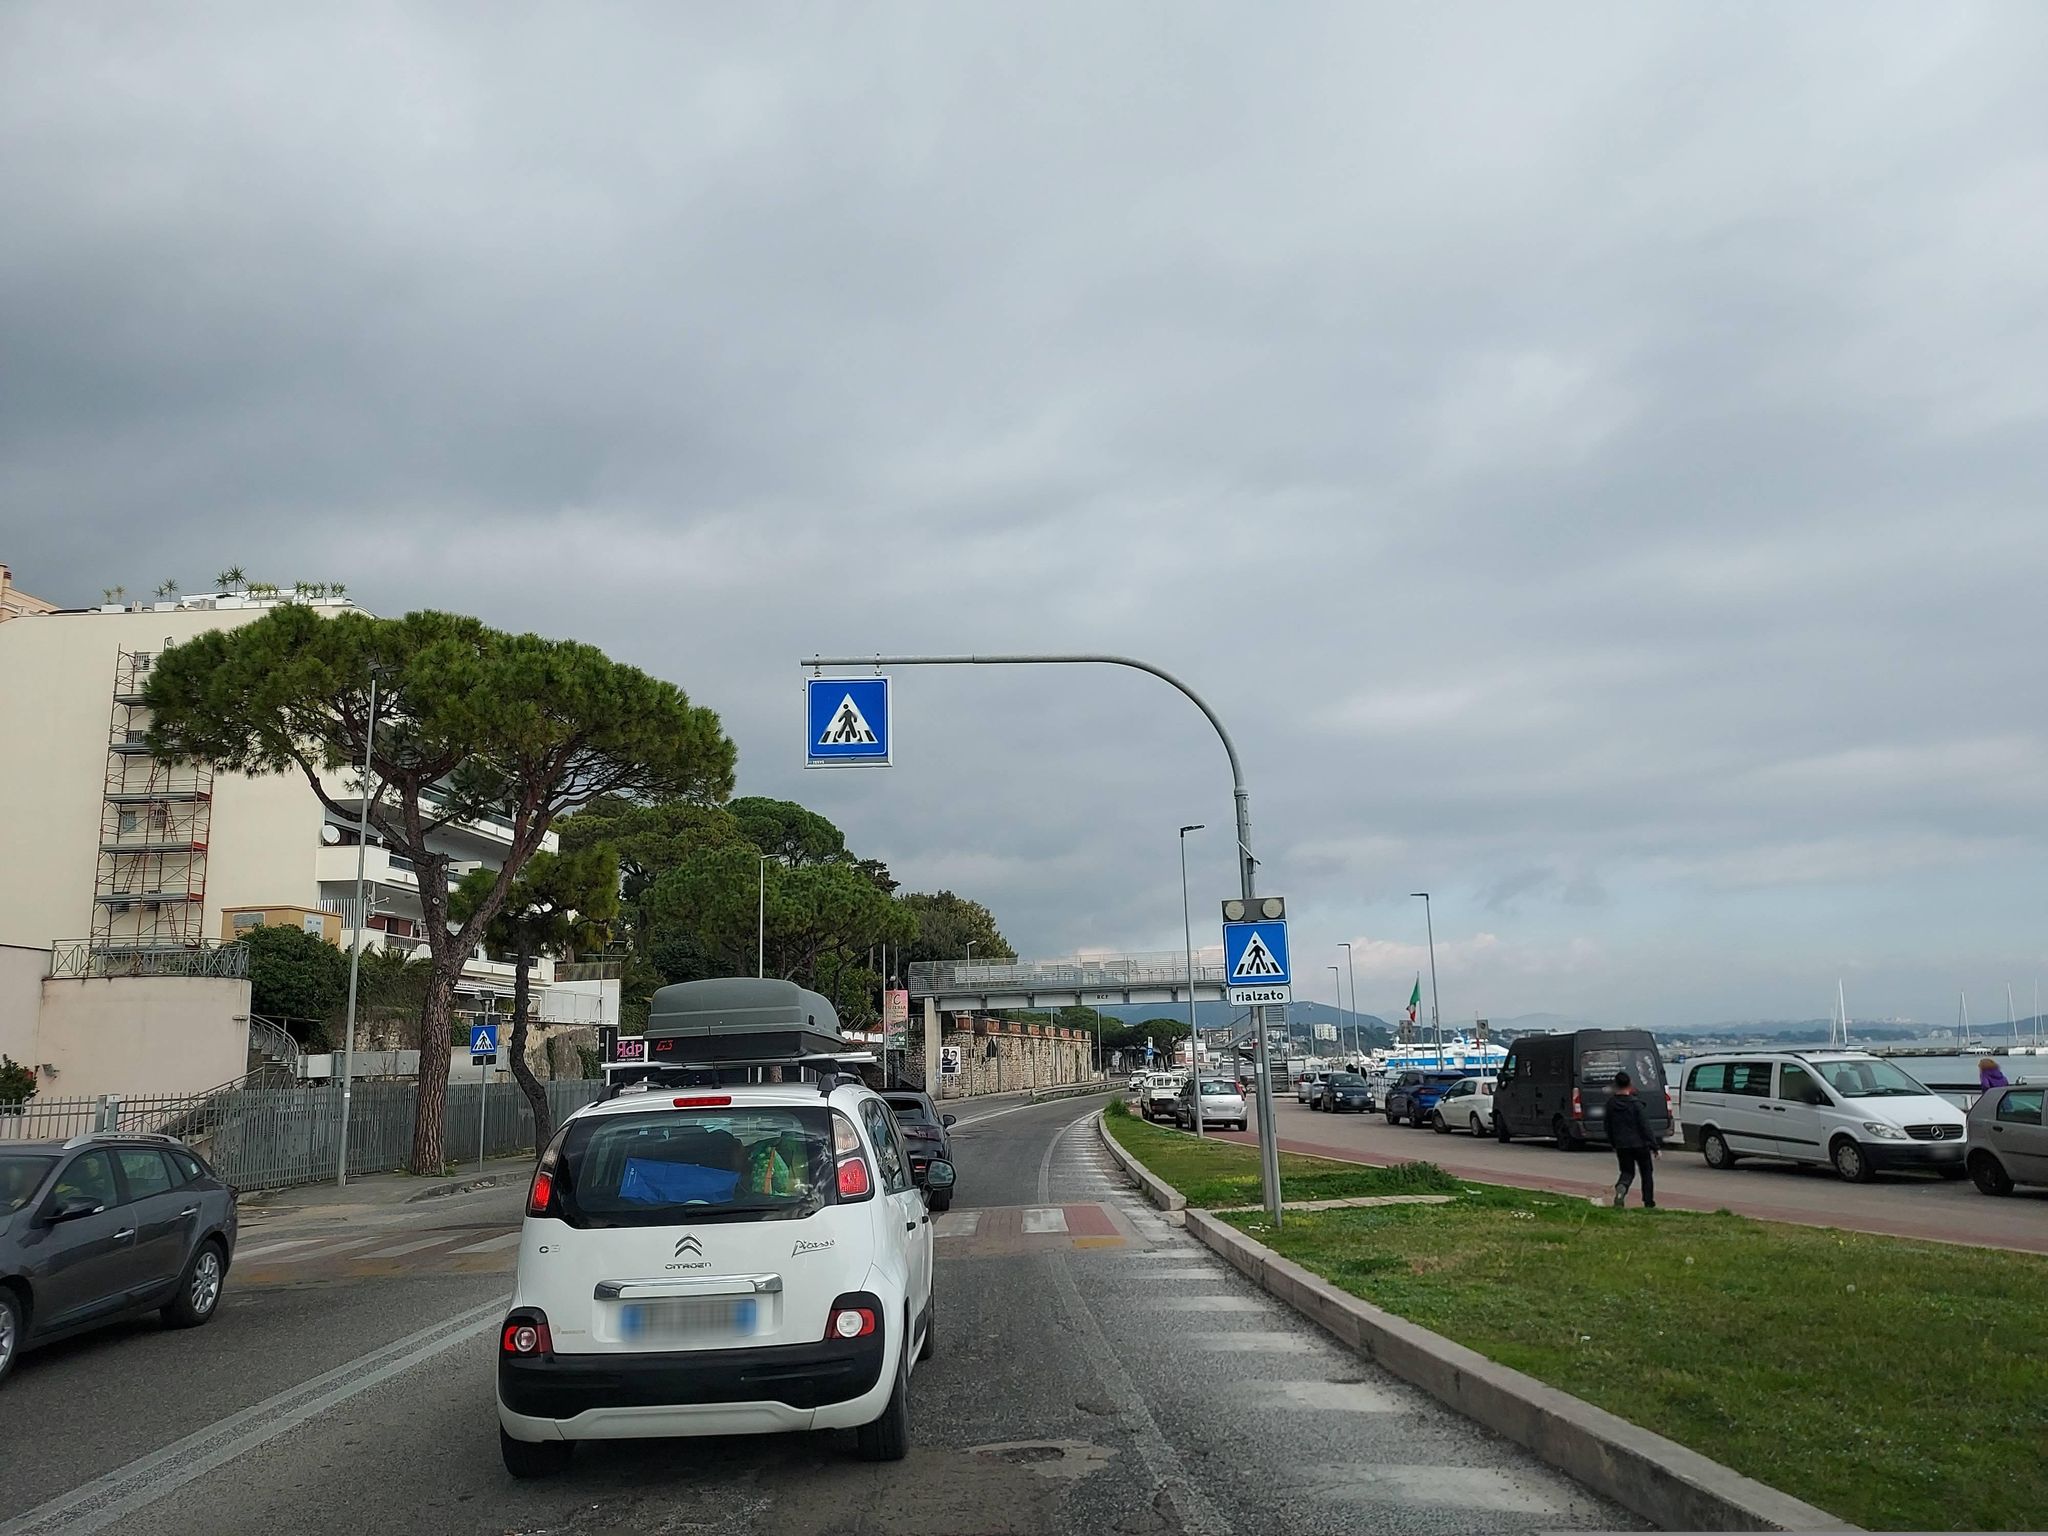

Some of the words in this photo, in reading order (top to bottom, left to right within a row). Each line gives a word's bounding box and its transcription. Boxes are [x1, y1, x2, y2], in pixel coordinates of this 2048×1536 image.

[1236, 990, 1285, 1002] rialzato
[539, 1243, 561, 1254] C3
[790, 1240, 836, 1258] Picasso
